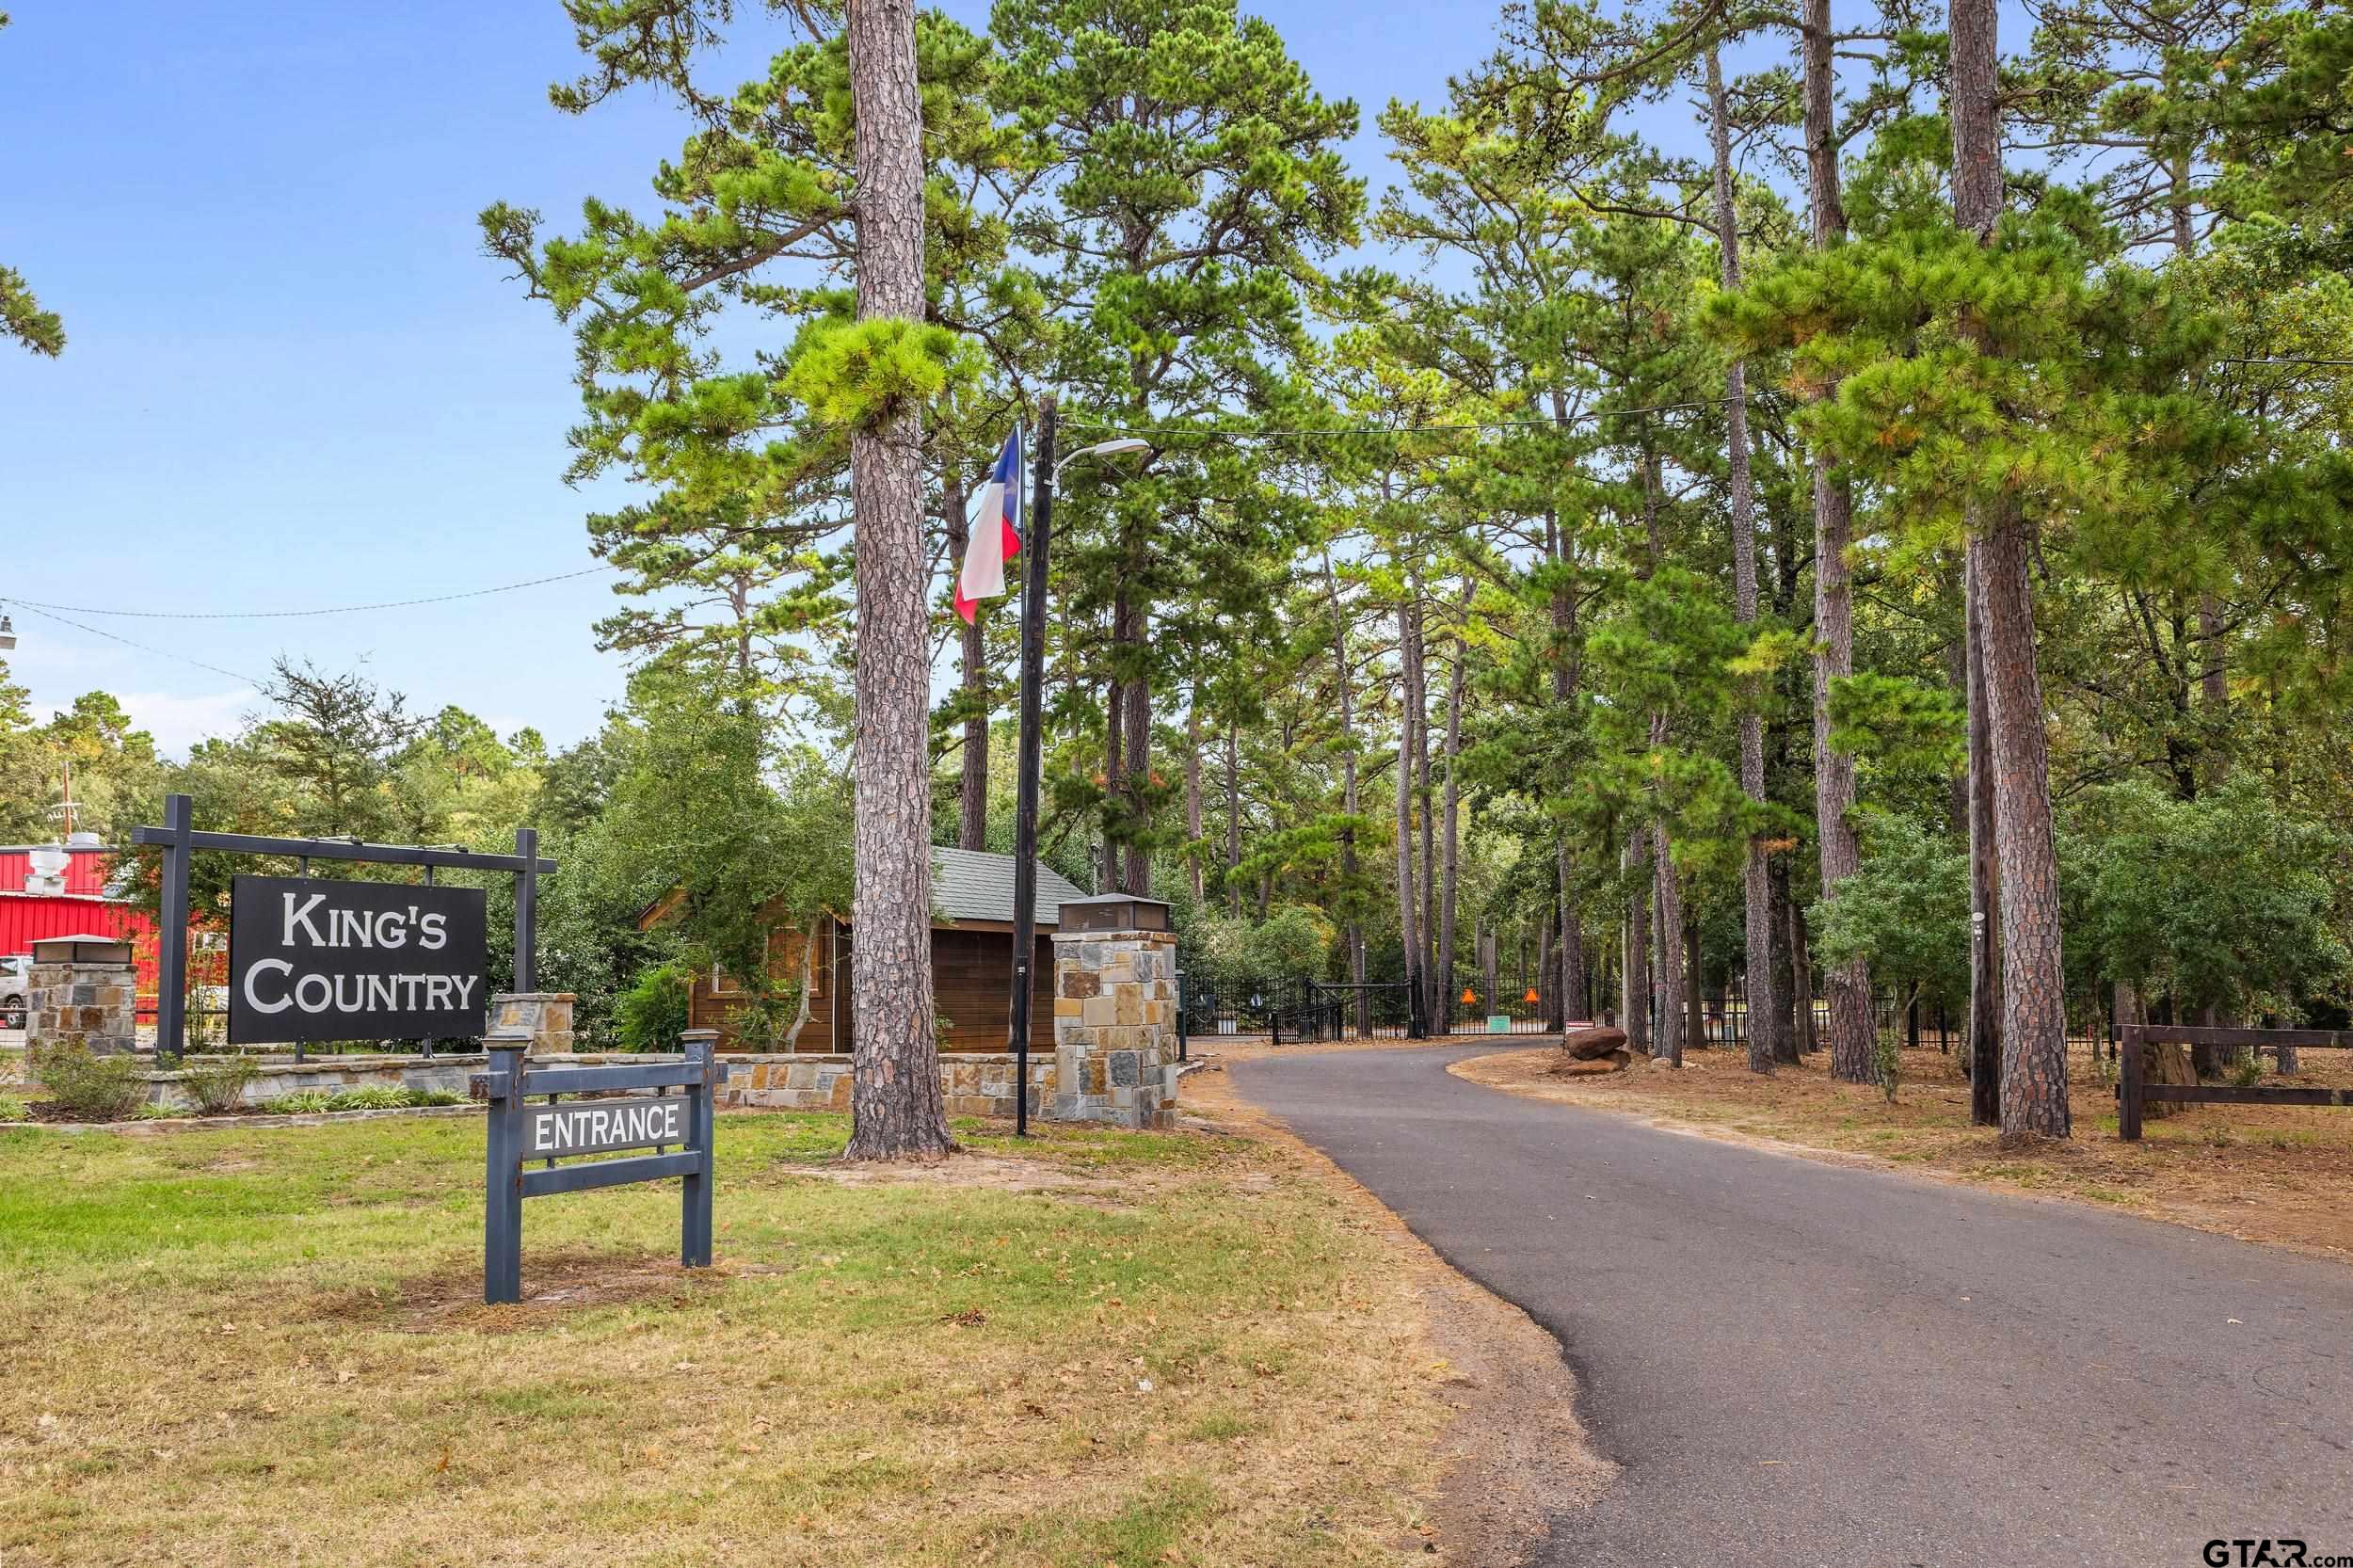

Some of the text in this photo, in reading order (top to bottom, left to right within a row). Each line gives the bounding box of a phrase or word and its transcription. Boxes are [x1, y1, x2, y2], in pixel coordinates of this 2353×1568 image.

[282, 892, 447, 950] KING'S
[244, 958, 478, 1014] COUNTRY
[535, 1103, 679, 1151] ENTRANCE
